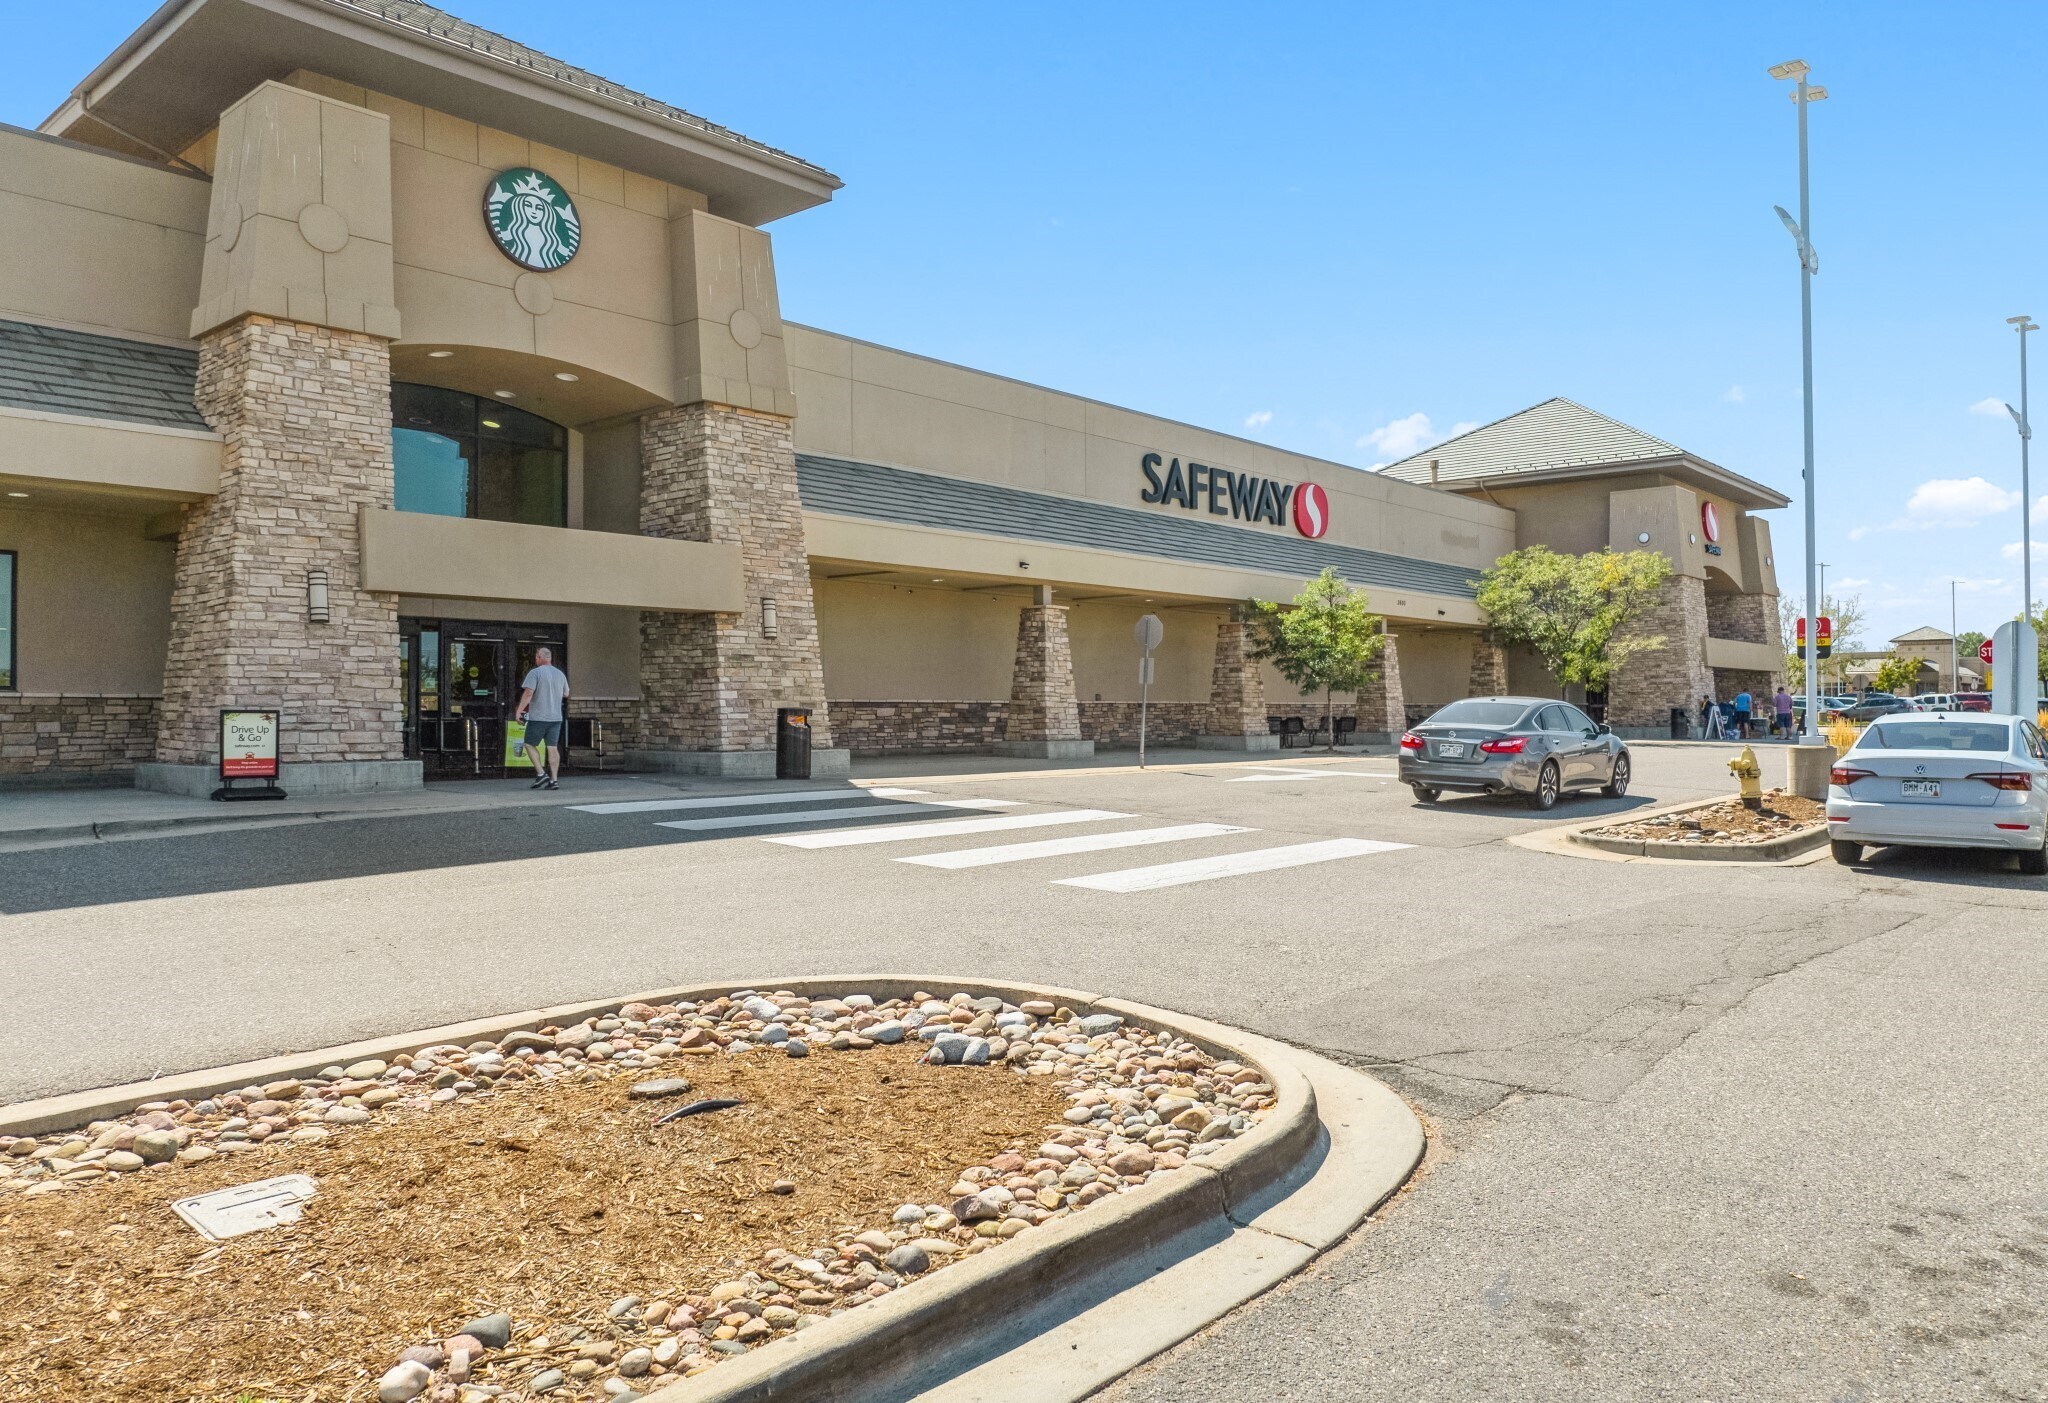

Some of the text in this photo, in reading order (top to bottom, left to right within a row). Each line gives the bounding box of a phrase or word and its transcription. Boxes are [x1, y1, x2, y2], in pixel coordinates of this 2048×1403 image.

[1141, 452, 1293, 526] SAFEWAY
[1980, 647, 1993, 657] ST
[231, 725, 270, 735] Drive Up
[238, 733, 262, 741] & Go
